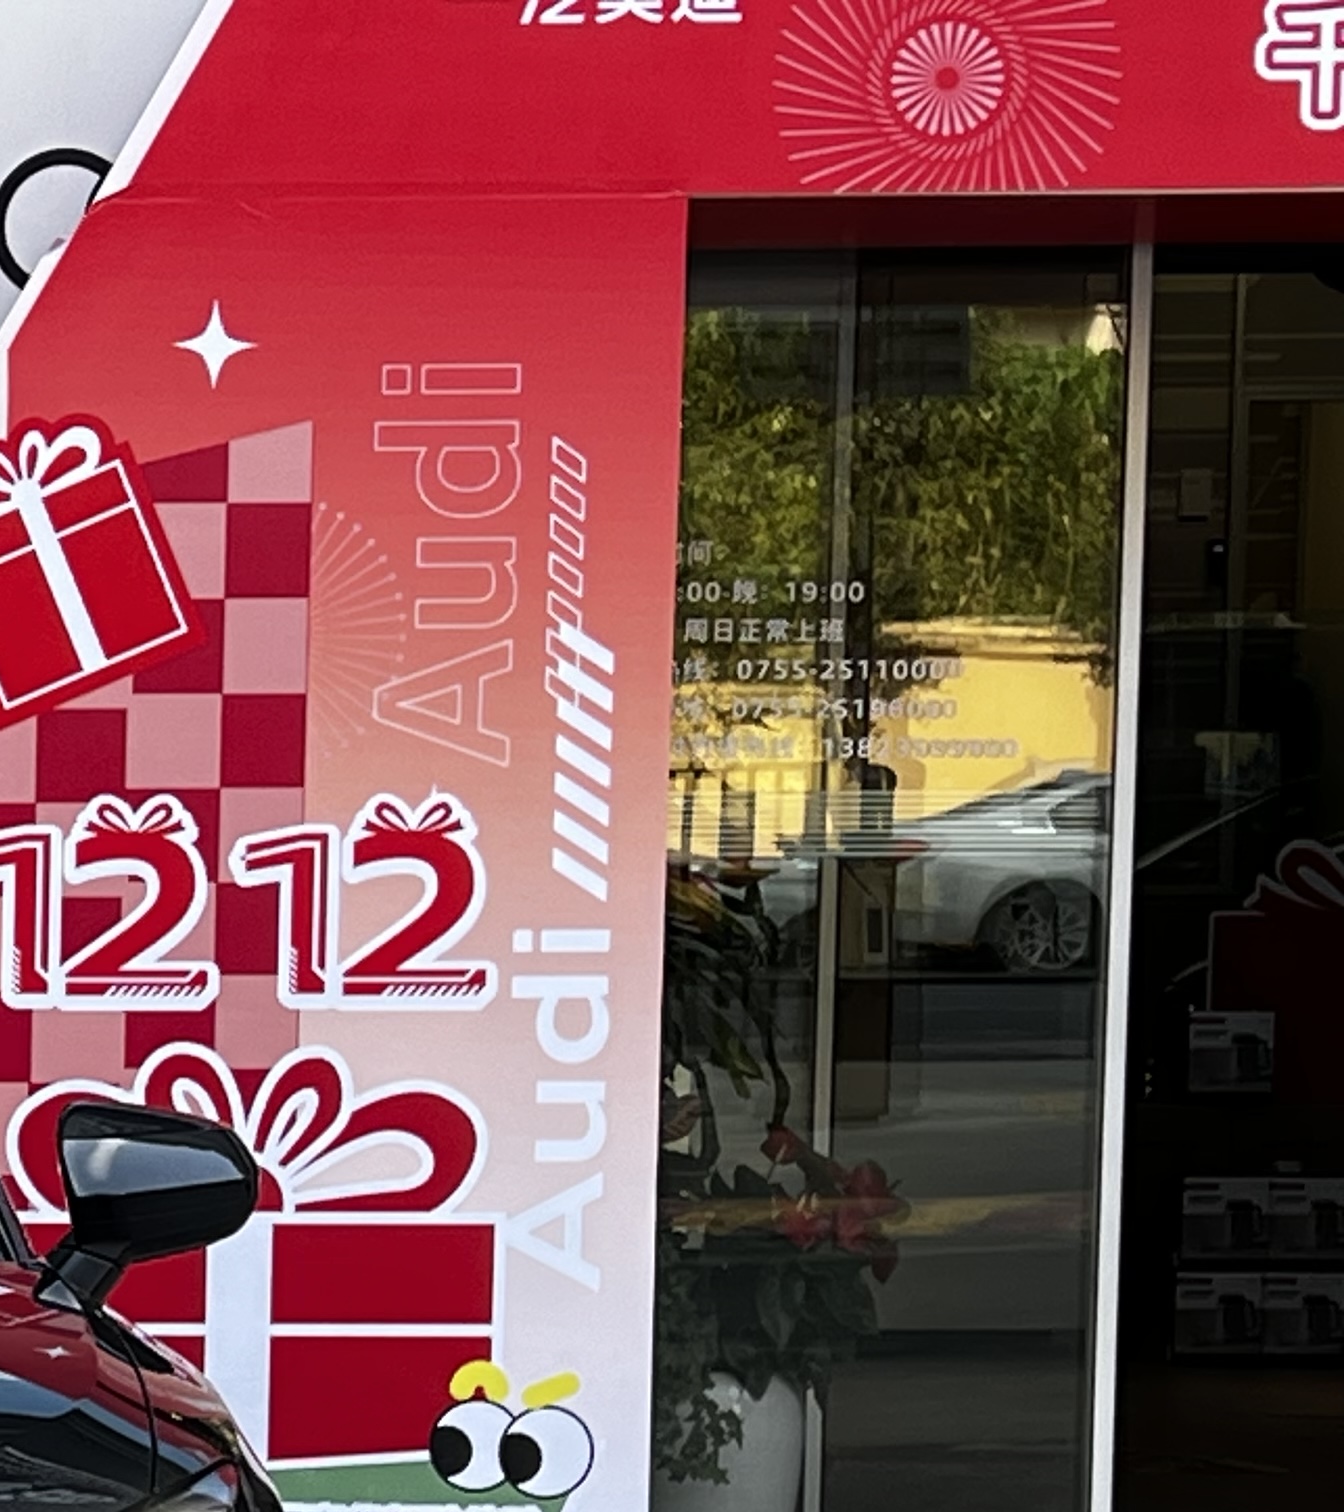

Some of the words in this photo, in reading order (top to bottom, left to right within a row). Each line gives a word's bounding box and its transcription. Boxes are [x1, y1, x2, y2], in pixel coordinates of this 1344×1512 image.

[373, 363, 522, 767] Audi
[683, 617, 845, 643] 周日正常上班
[506, 928, 612, 1294] Audi
